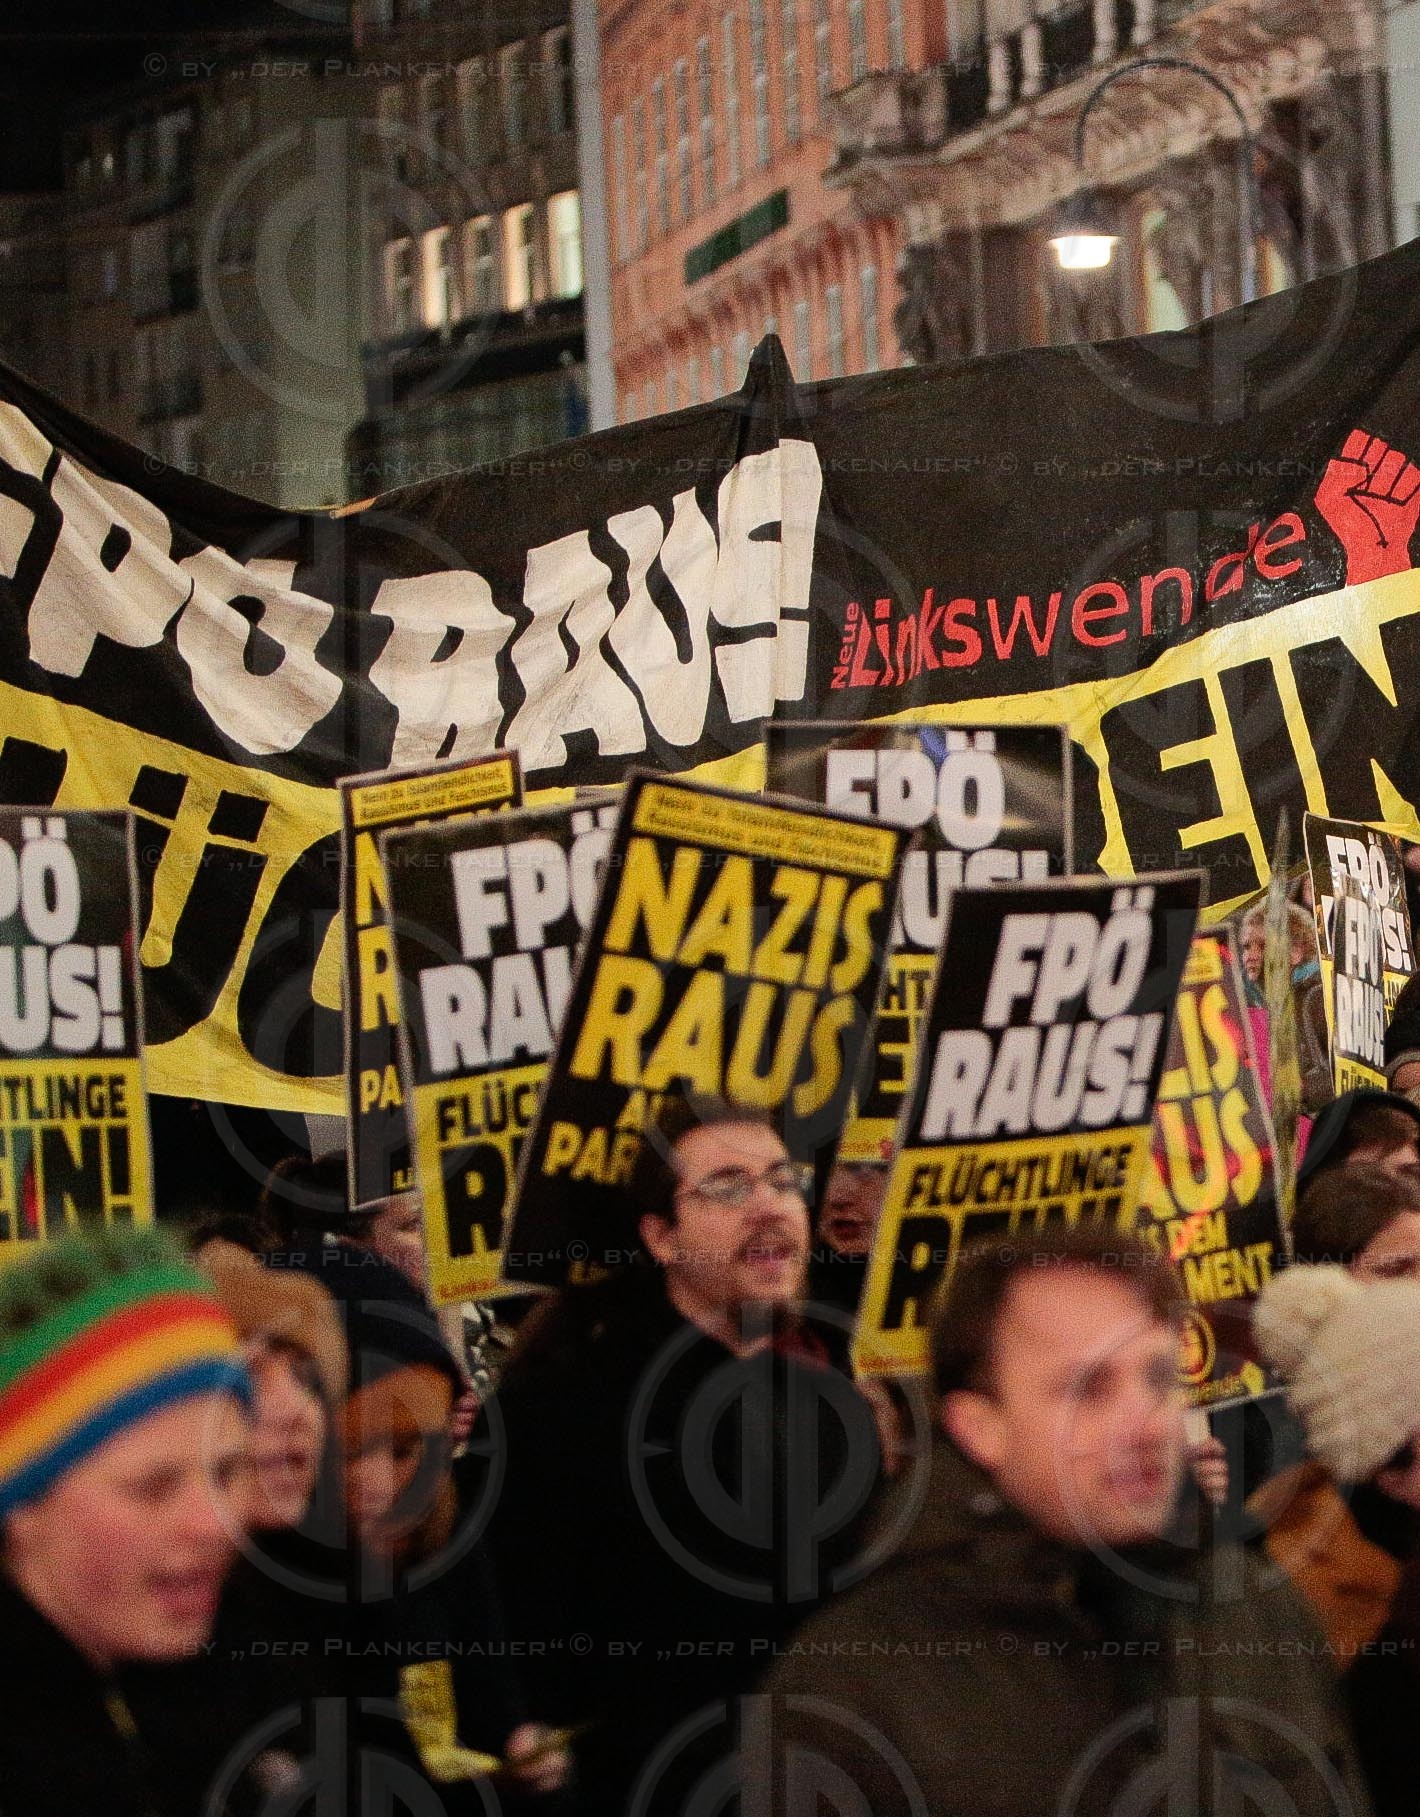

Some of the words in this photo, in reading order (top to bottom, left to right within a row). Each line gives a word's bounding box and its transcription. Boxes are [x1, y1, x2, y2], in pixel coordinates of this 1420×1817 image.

[369, 437, 823, 773] RAUS!
[831, 601, 860, 689] Neue
[603, 837, 887, 995] NAZIS
[982, 885, 1155, 1028] FPÖ
[570, 953, 856, 1118] RAUS
[920, 1011, 1165, 1142] RAUS!
[906, 1142, 1135, 1208] FLÜCHTLINGE
